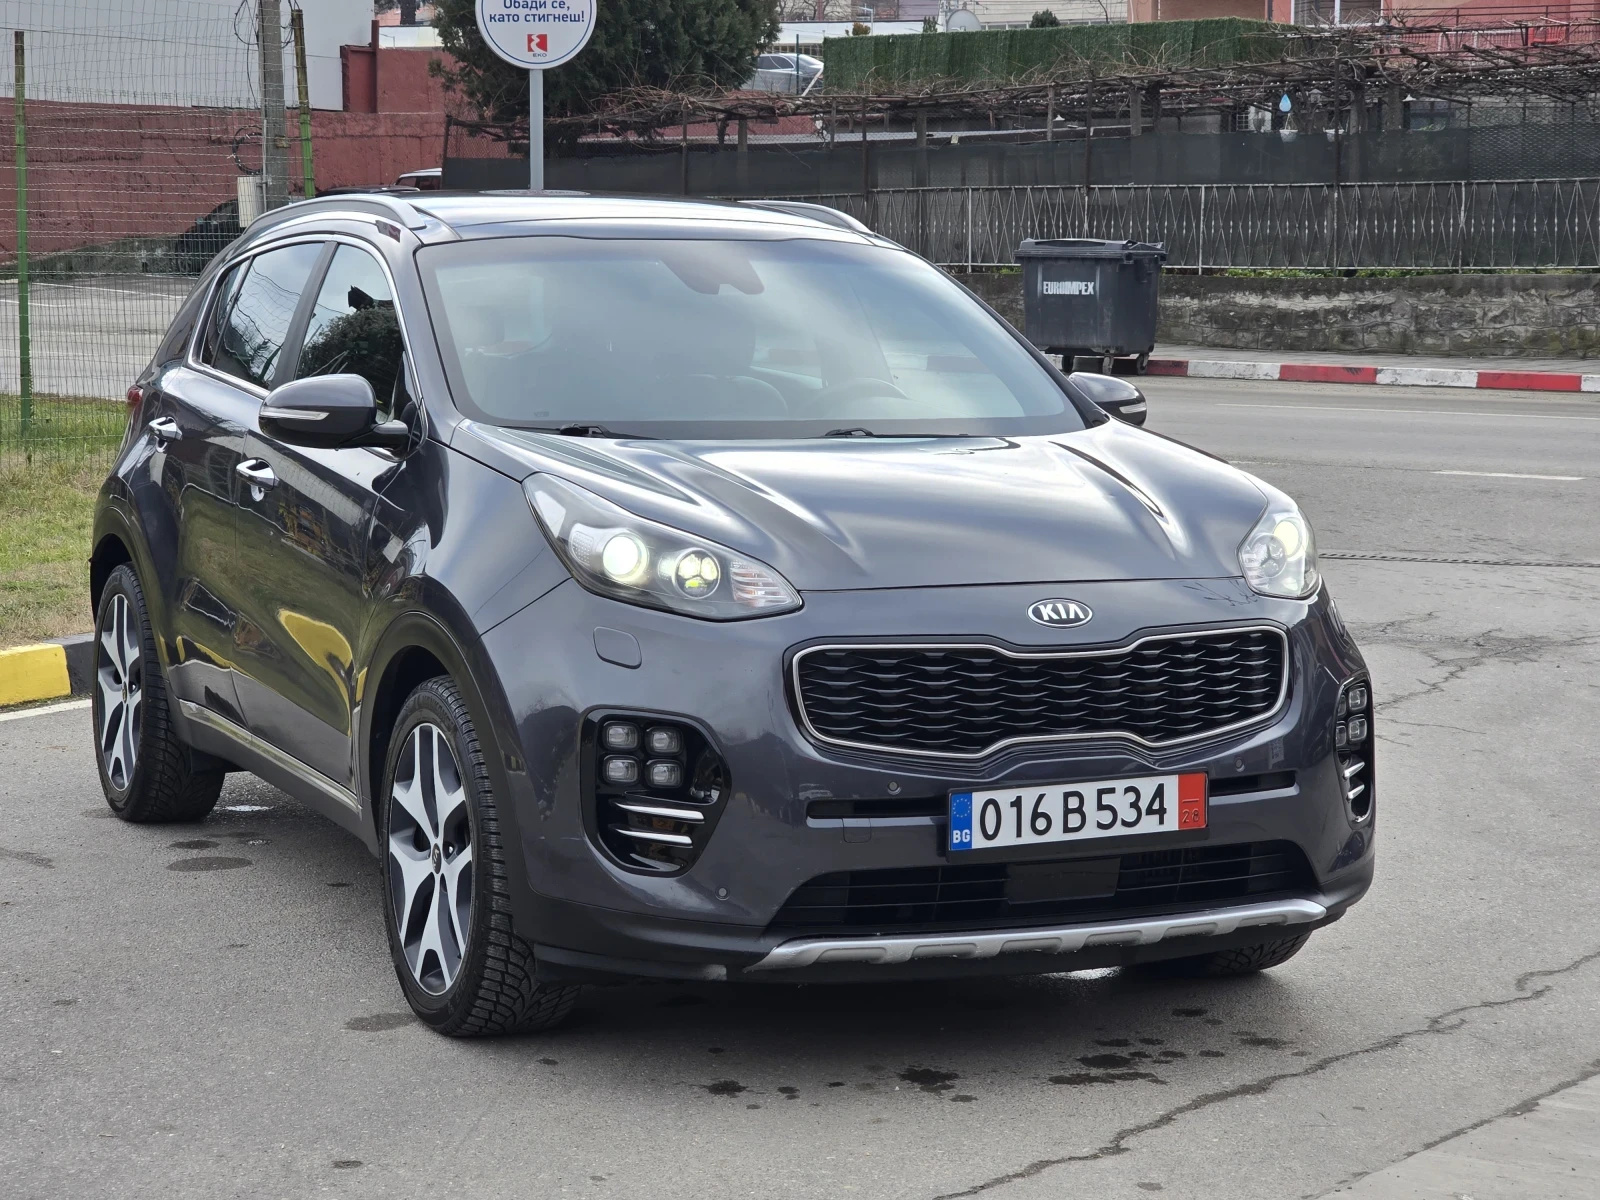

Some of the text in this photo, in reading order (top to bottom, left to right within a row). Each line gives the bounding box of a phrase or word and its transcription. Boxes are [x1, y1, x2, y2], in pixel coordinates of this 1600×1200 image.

[503, 0, 570, 11] Обади се,
[489, 11, 585, 22] като стигнеш!
[1043, 281, 1095, 295] EUROIMPEX
[1038, 603, 1086, 621] KIA
[952, 829, 971, 844] BG
